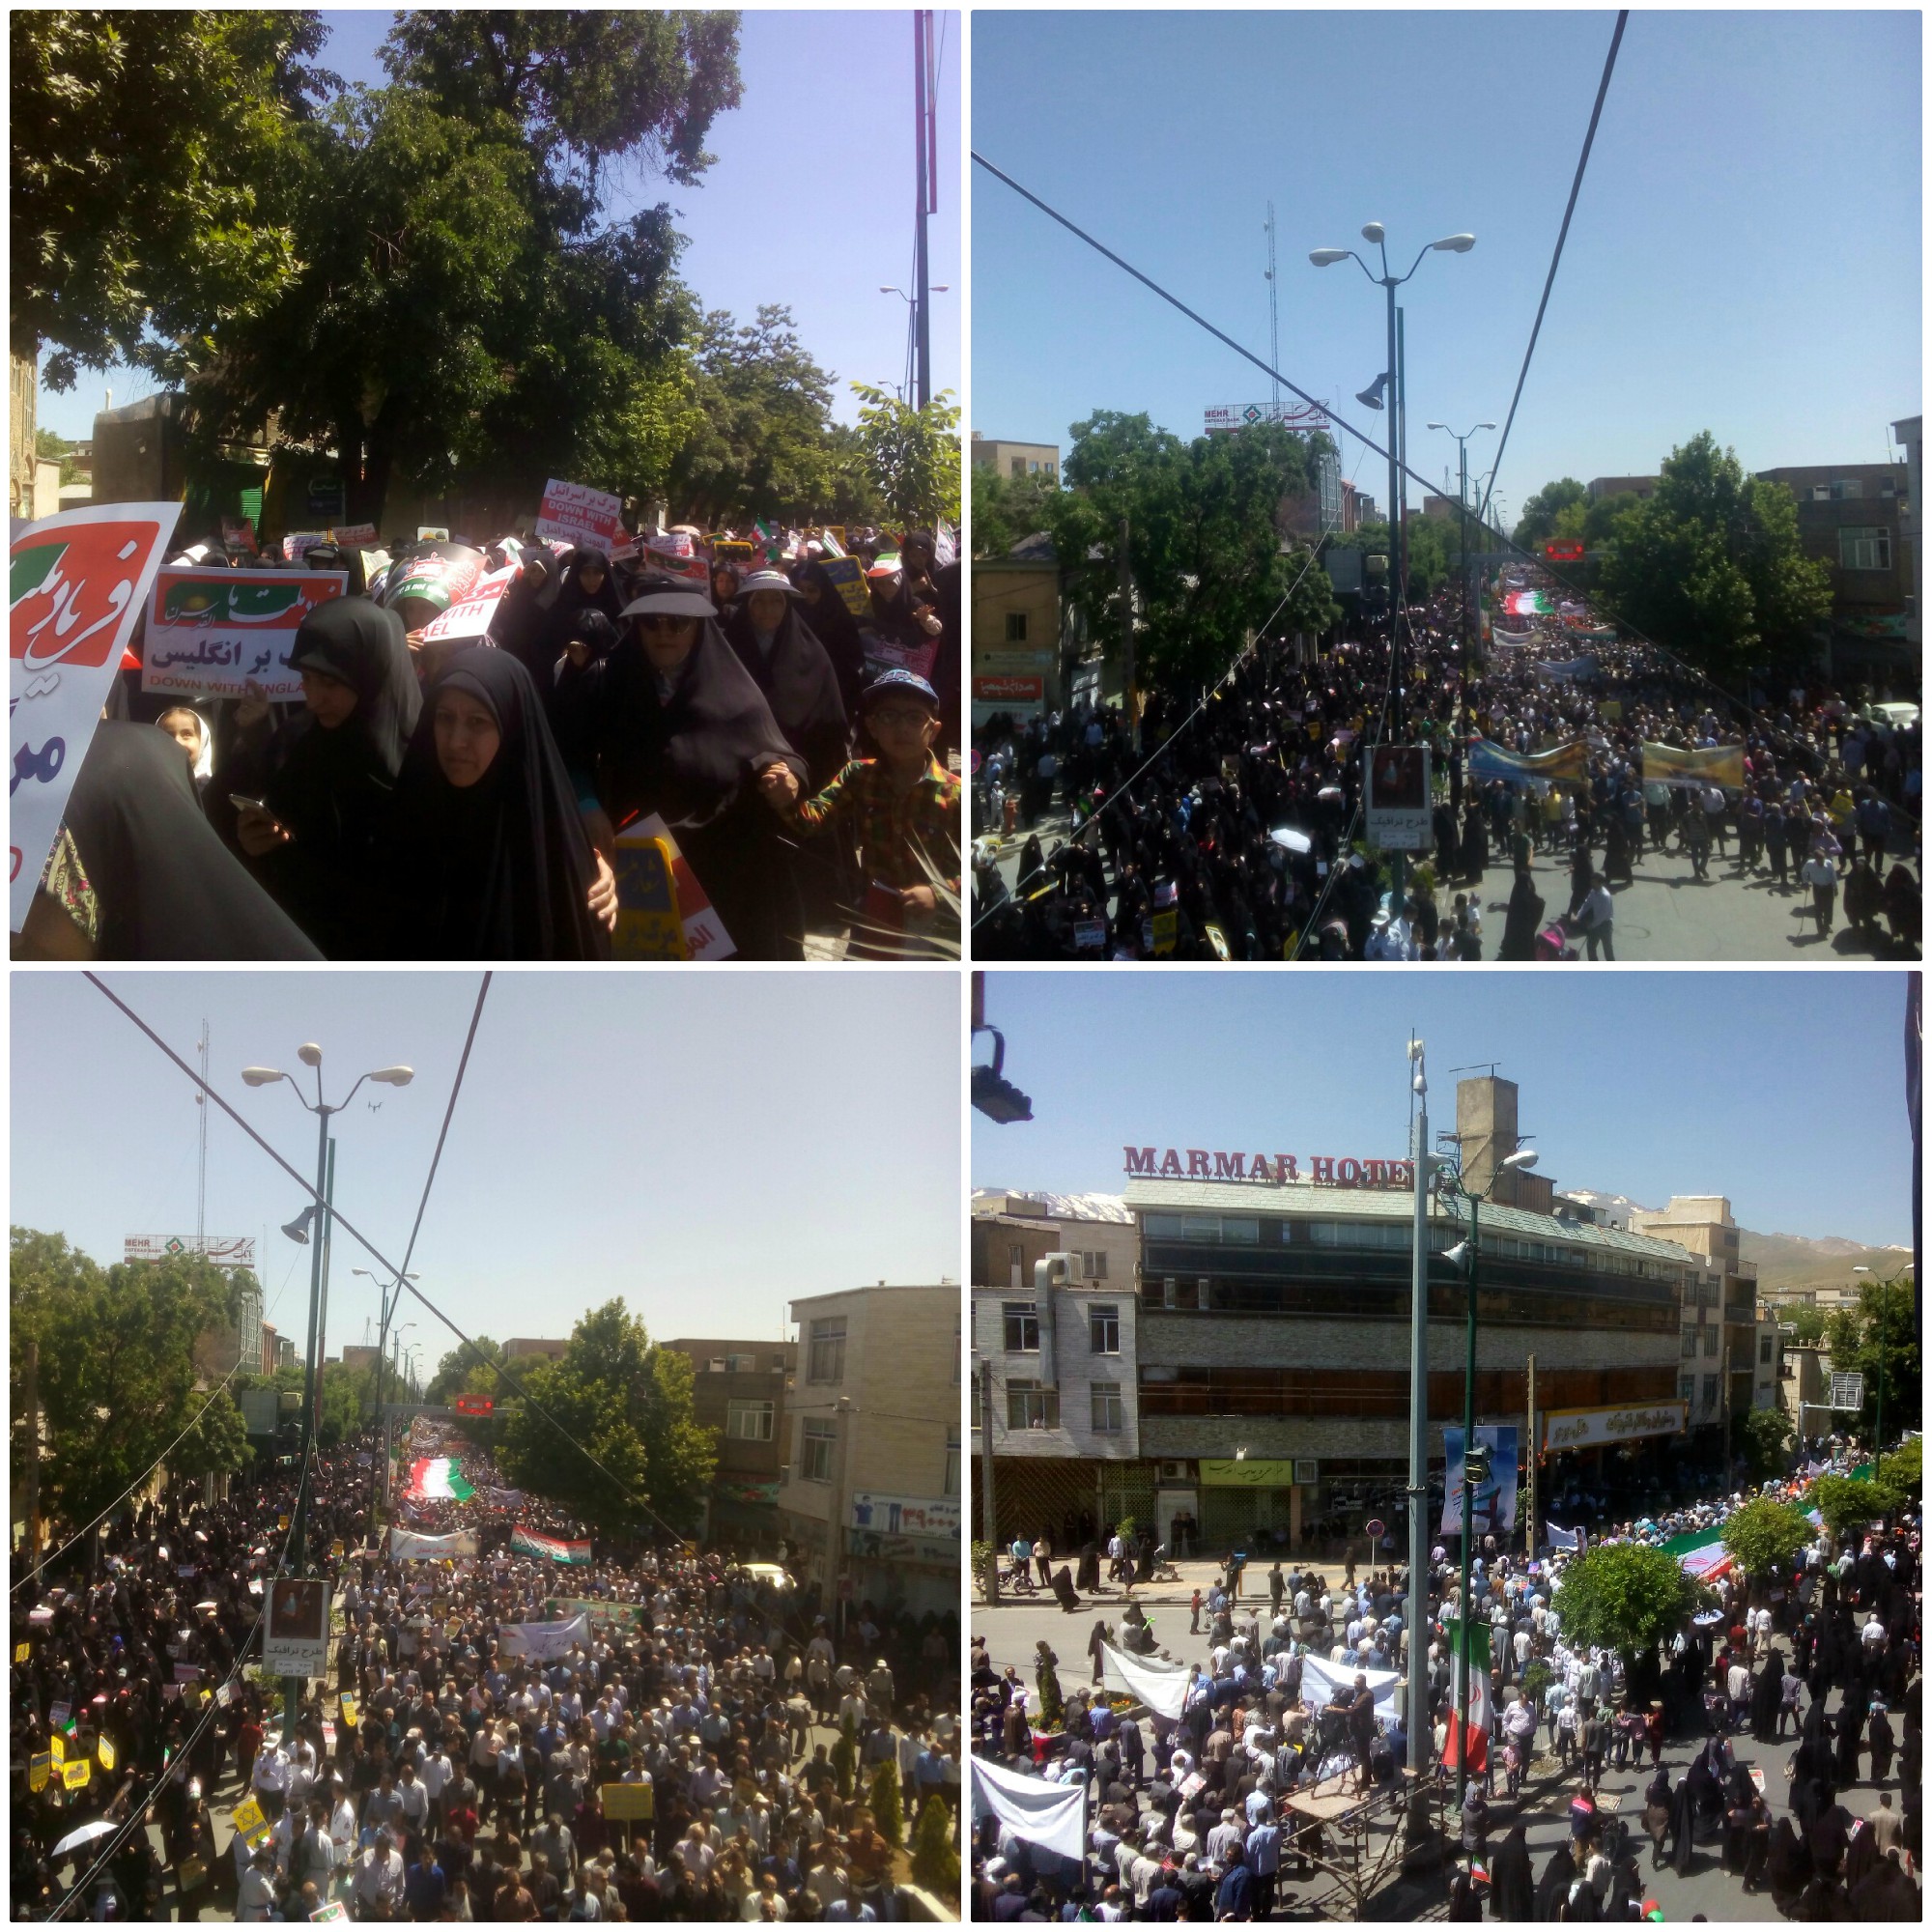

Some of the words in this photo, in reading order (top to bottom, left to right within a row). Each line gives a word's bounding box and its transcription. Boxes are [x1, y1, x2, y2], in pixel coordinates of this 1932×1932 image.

[1205, 410, 1229, 418] MEHR
[586, 497, 596, 506] بر
[597, 497, 616, 511] مرگ
[549, 500, 583, 516] DOWN
[586, 508, 611, 525] WITH
[557, 514, 596, 531] ISRAEL
[152, 639, 242, 669] انگلیس
[246, 648, 271, 675] بر
[150, 676, 201, 690] DOWN
[208, 681, 246, 695] WITH
[1122, 1146, 1300, 1180] MARMAR
[1310, 1155, 1415, 1186] HOTE
[125, 1238, 150, 1247] MEHR
[267, 1645, 299, 1656] ترافیک
[301, 1647, 323, 1658] طرح
